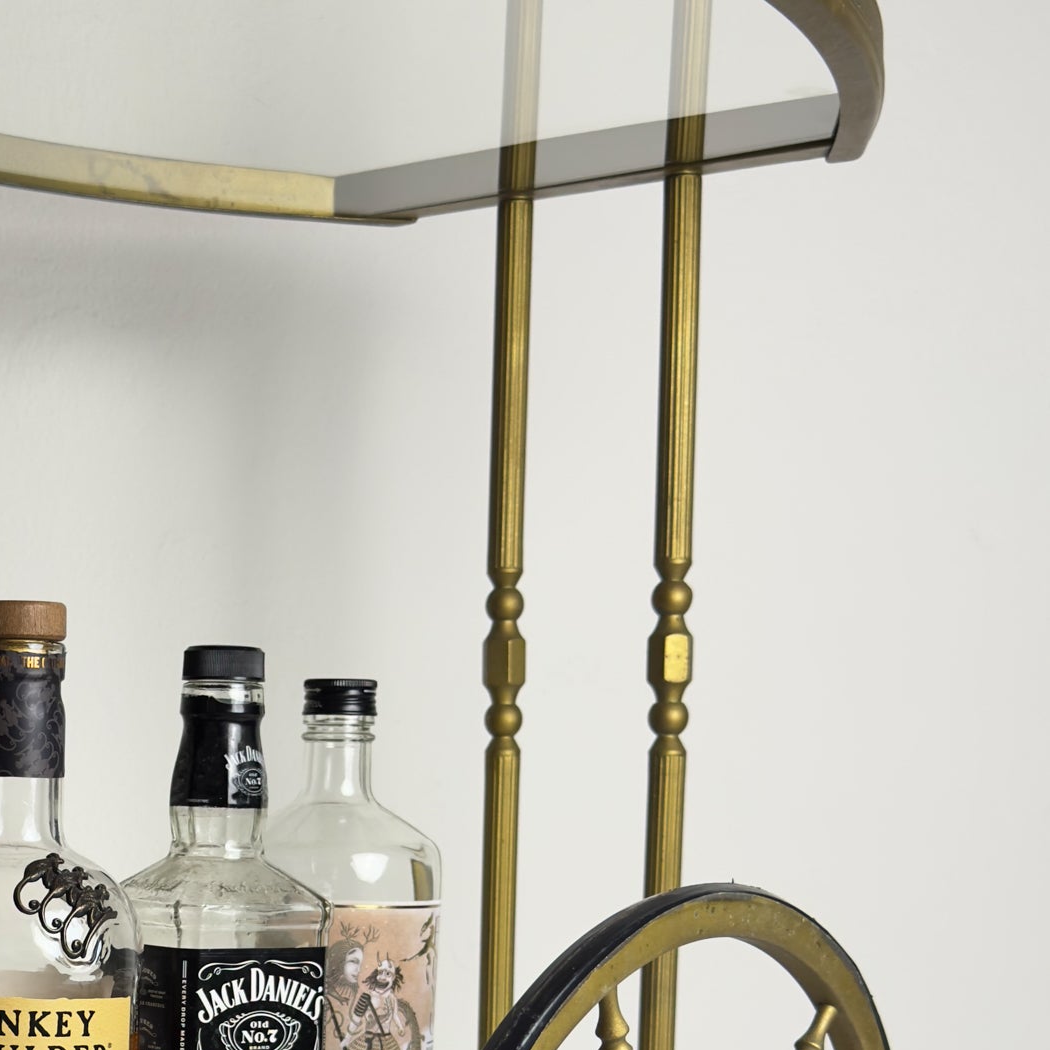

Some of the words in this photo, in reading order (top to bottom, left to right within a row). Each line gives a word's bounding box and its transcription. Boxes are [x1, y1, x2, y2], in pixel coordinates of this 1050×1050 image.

[196, 977, 249, 1023] JACK
[250, 967, 325, 1021] DANIEL'S
[250, 1020, 269, 1029] Old
[241, 1029, 278, 1044] No.7
